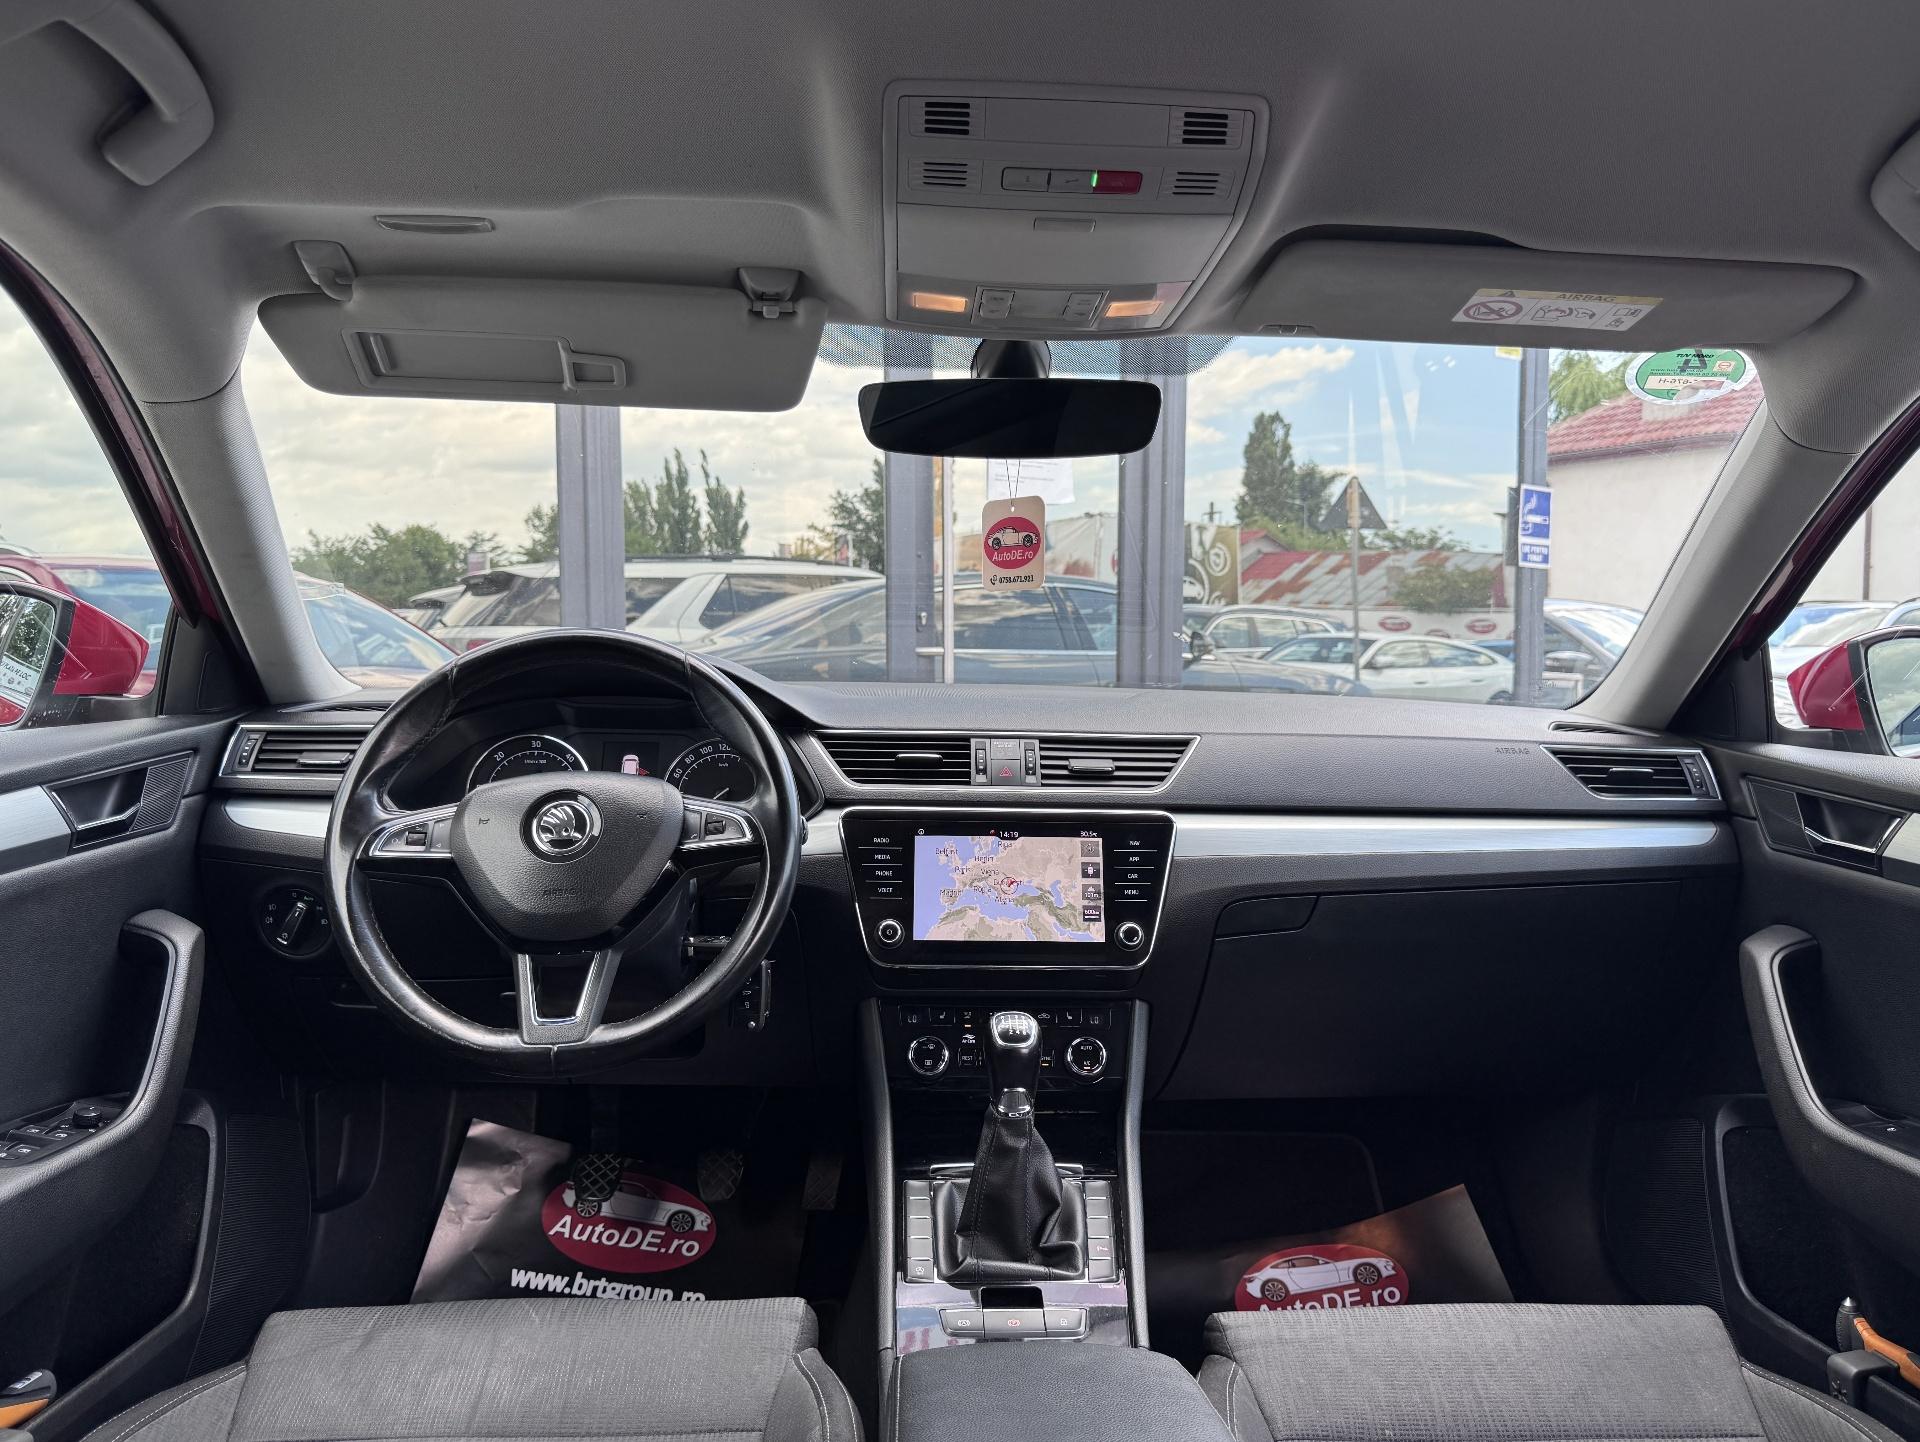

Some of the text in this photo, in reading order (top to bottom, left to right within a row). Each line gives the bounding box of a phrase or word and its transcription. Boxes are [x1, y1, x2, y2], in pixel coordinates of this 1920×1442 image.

[1556, 293, 1616, 303] AIRBAG
[992, 550, 1034, 562] AutoDE.ro
[531, 740, 541, 748] 30
[699, 745, 713, 755] 100
[1494, 747, 1531, 755] AIRBAG
[494, 751, 505, 761] 20
[565, 753, 575, 763] 40
[684, 754, 695, 764] 80
[673, 768, 683, 778] 60
[549, 1214, 700, 1257] AutoDE.ro
